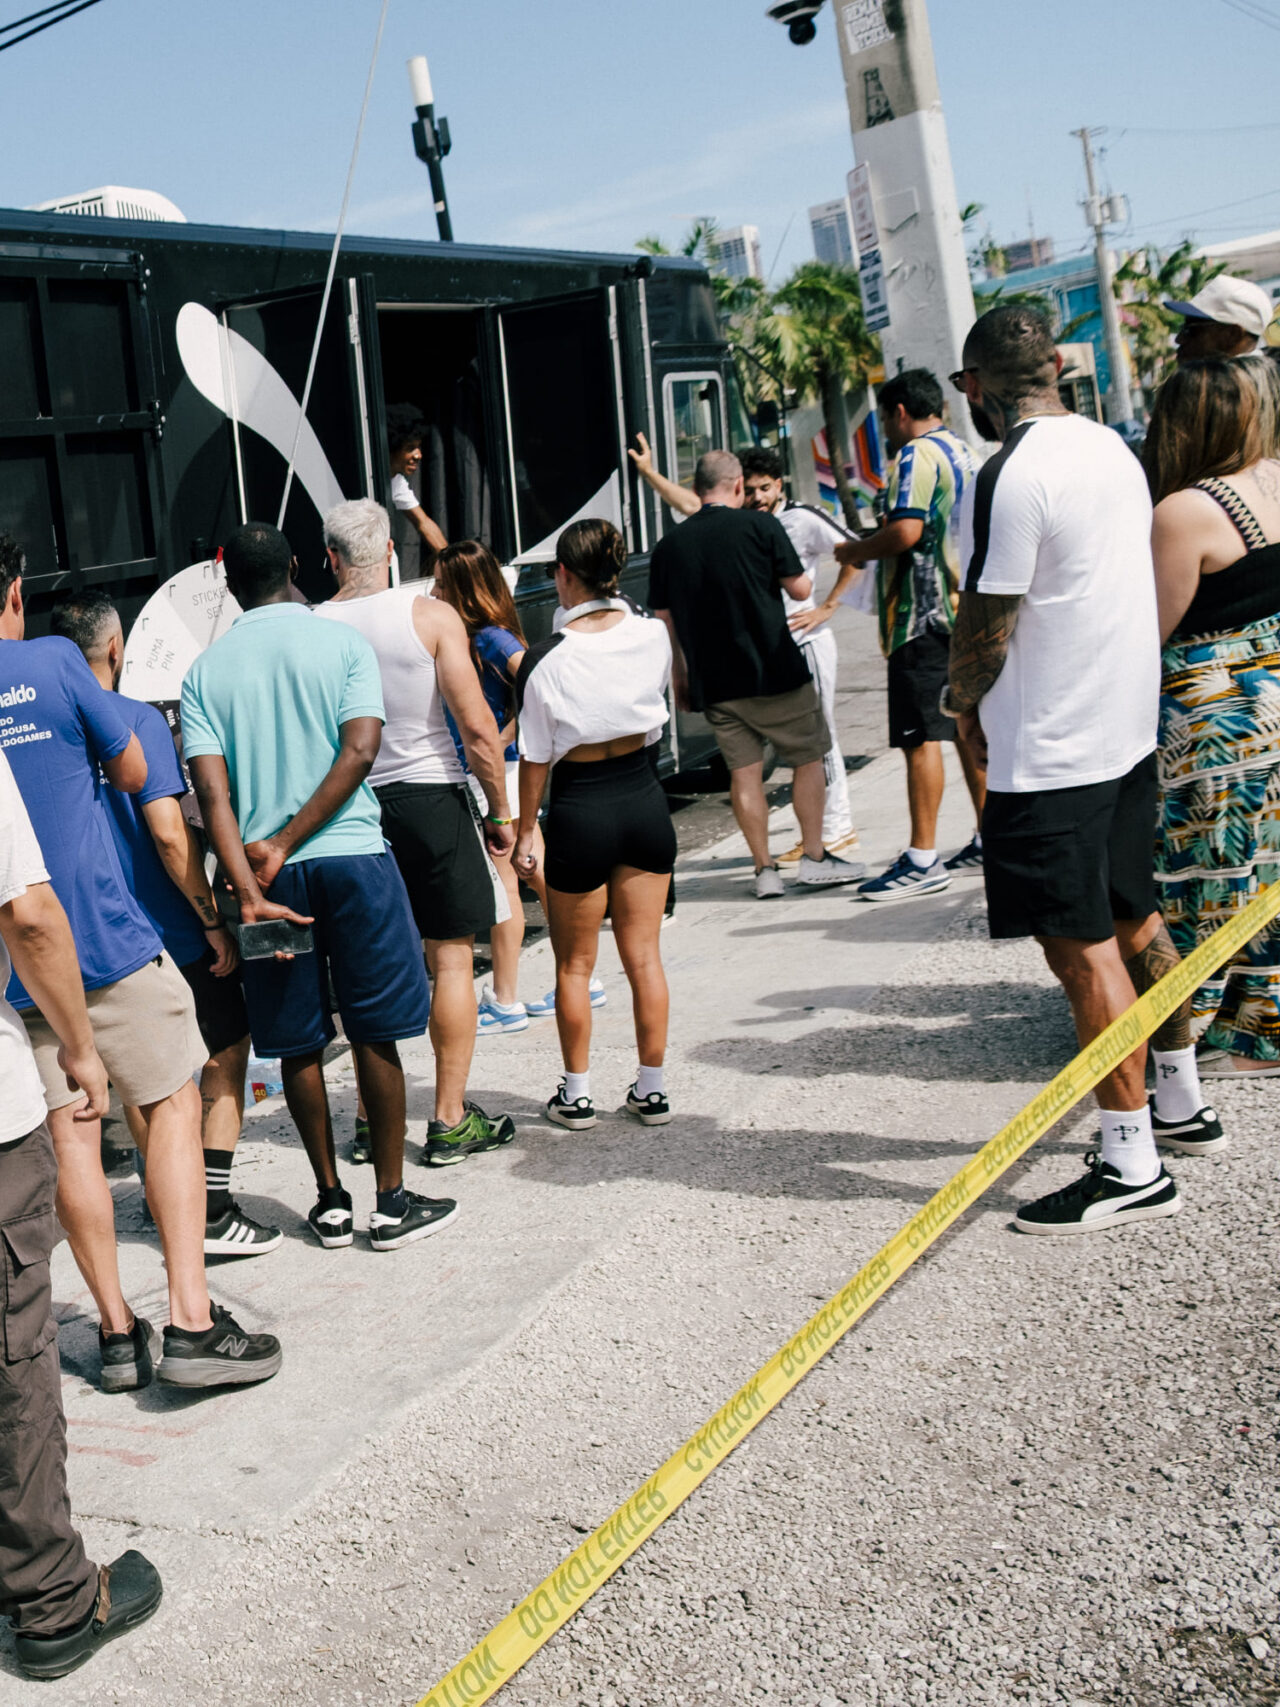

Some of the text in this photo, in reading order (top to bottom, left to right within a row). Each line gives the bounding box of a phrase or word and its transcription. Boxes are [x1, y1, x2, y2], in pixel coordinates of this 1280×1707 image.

[207, 604, 223, 620] SET
[146, 638, 164, 670] PUMA
[161, 650, 175, 671] PIN
